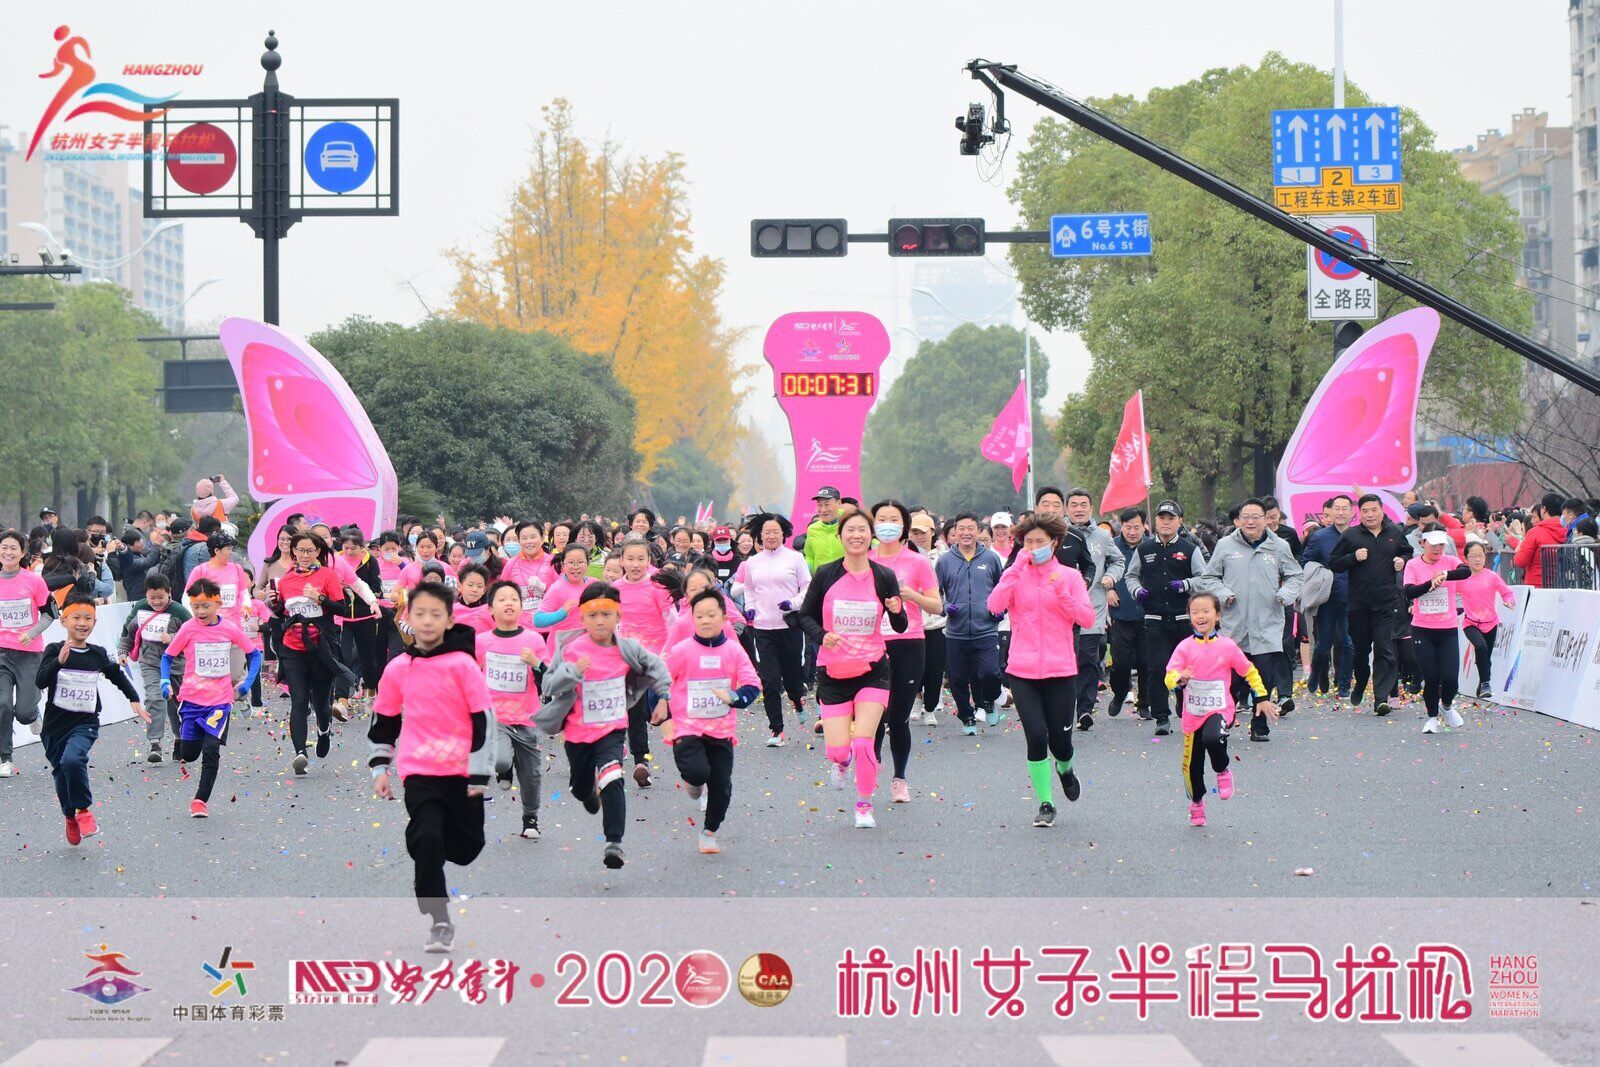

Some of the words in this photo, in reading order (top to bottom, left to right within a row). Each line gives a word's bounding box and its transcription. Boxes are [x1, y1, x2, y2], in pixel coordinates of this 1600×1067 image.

[1296, 169, 1300, 181] 1
[1332, 171, 1343, 185] 2
[1371, 167, 1380, 178] 3
[1280, 188, 1397, 208] 工程车走第2车道
[1081, 219, 1148, 239] 6号大街
[1092, 241, 1115, 251] No.6
[1121, 240, 1134, 250] St
[1315, 288, 1372, 309] 全路段
[784, 375, 871, 395] 00:07:31
[2, 610, 29, 620] B4236
[140, 623, 164, 633] 4814
[488, 668, 523, 682] B3416
[60, 687, 95, 701] B4259
[1188, 695, 1222, 707] B3233
